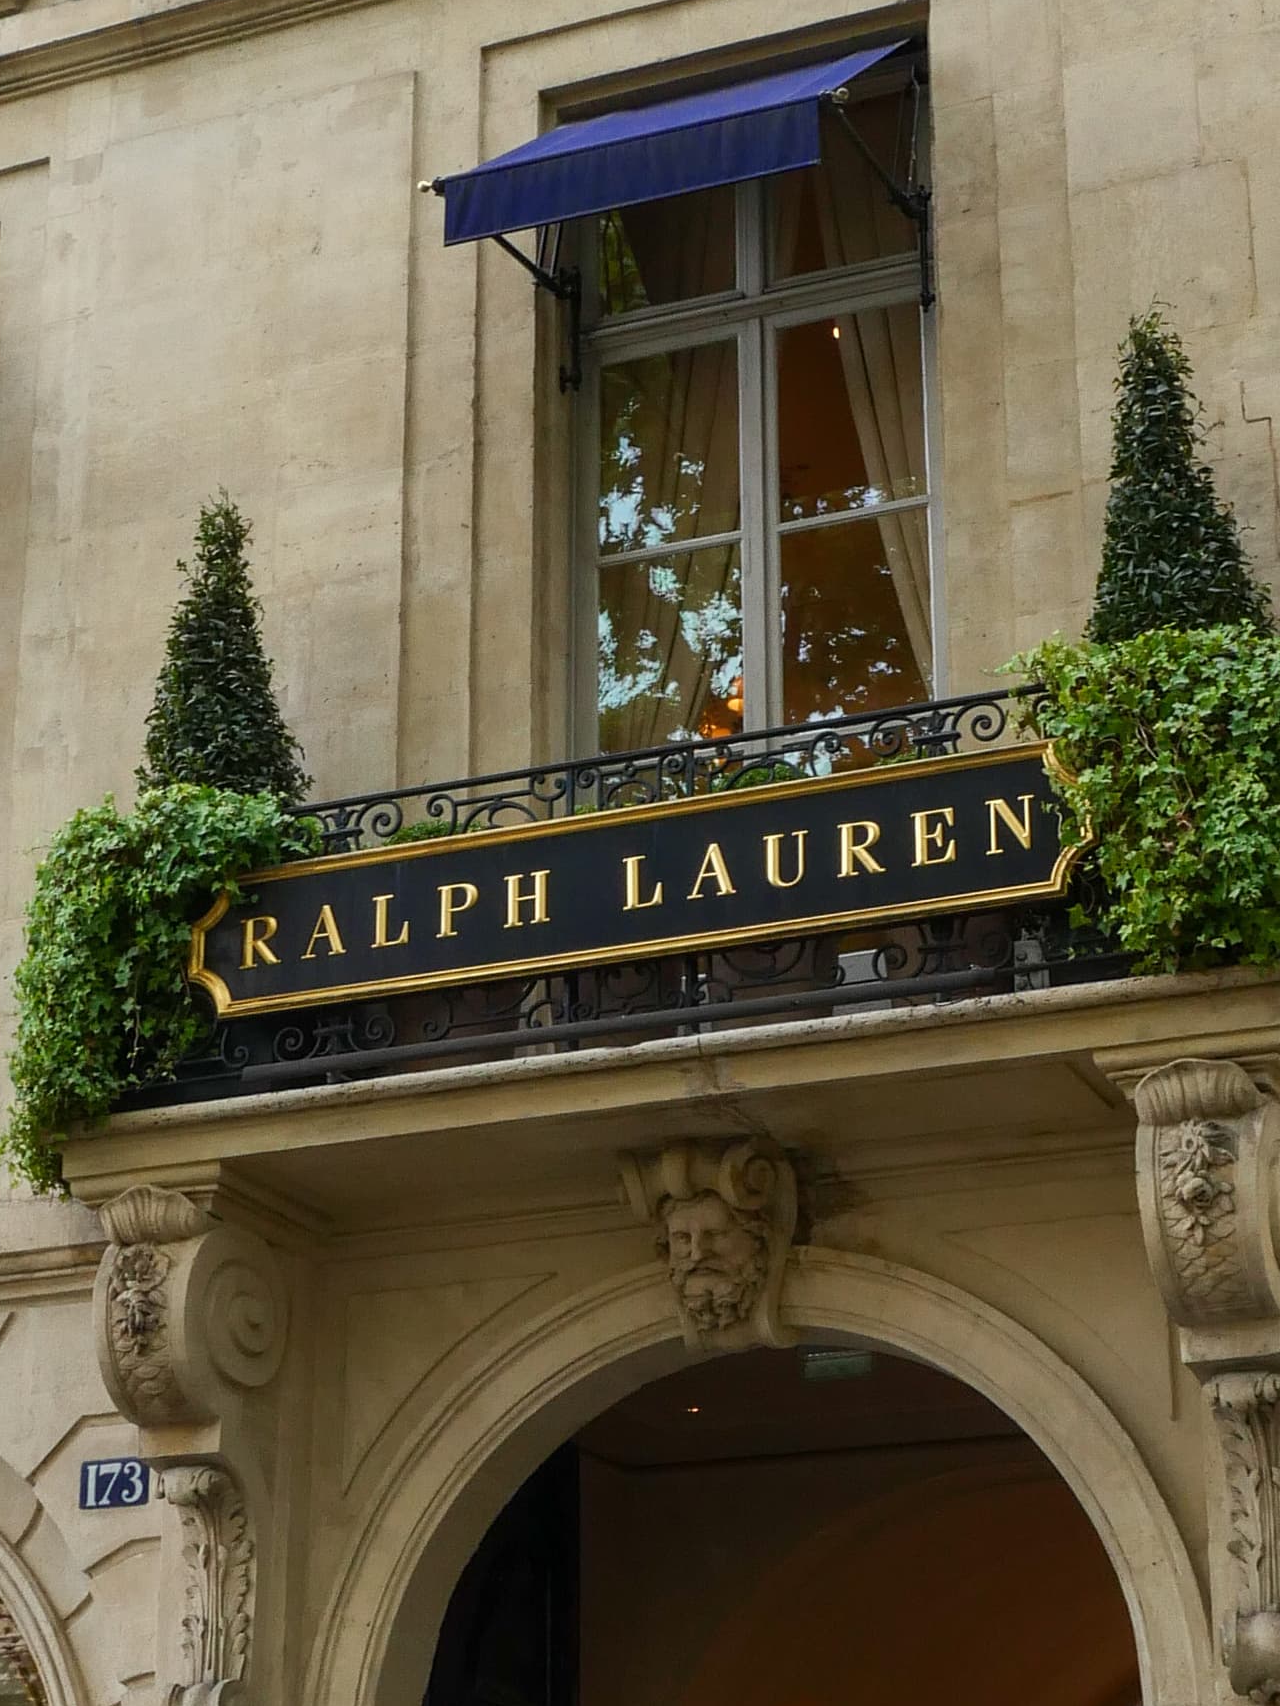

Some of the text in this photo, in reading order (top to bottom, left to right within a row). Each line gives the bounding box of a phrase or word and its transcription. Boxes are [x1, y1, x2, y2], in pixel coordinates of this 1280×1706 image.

[239, 793, 1033, 970] RALPH LAUREN
[86, 1461, 143, 1507] 173
